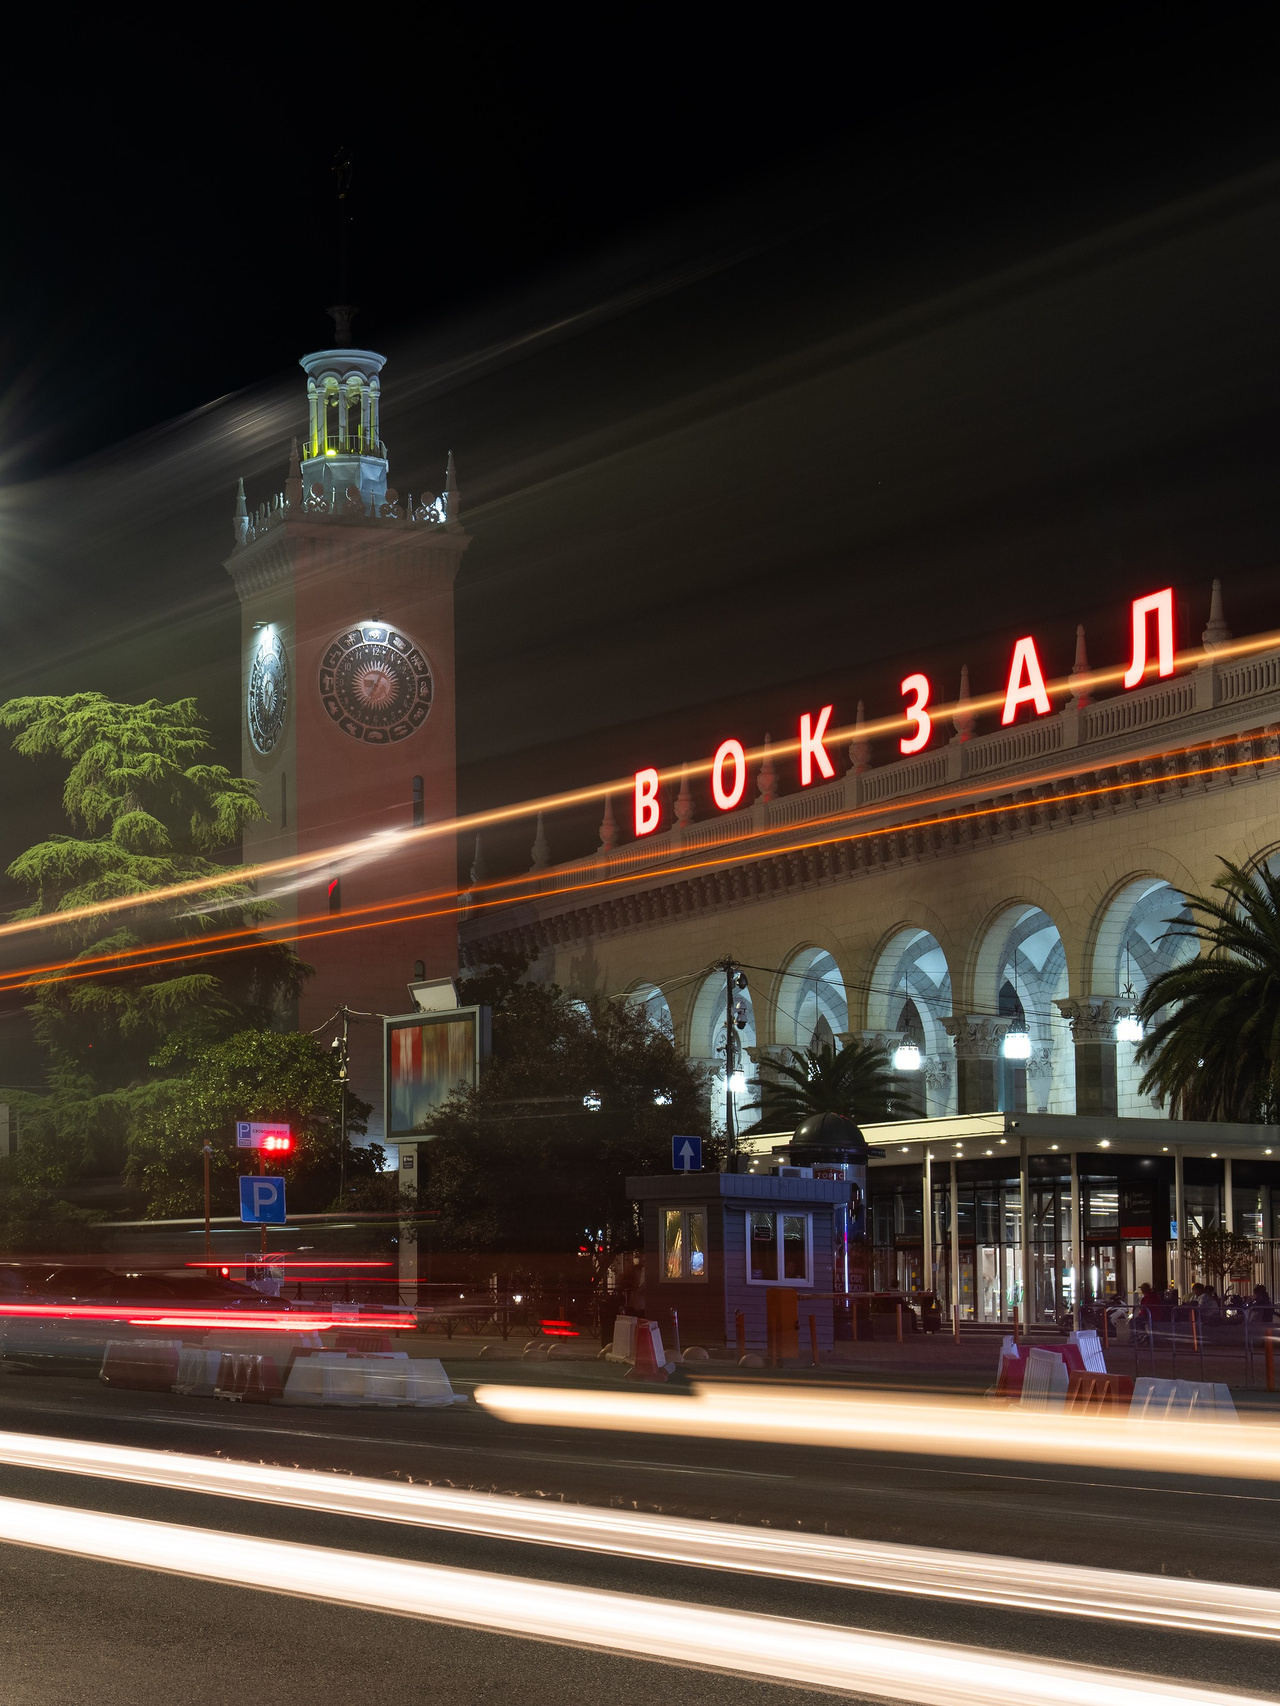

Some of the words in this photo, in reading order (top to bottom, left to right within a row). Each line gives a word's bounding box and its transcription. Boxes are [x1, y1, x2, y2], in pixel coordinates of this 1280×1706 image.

[355, 651, 362, 660] 11
[372, 647, 380, 656] 12
[634, 587, 1175, 837] ВОКЗАЛ
[240, 1123, 250, 1138] P
[253, 1182, 278, 1218] P
